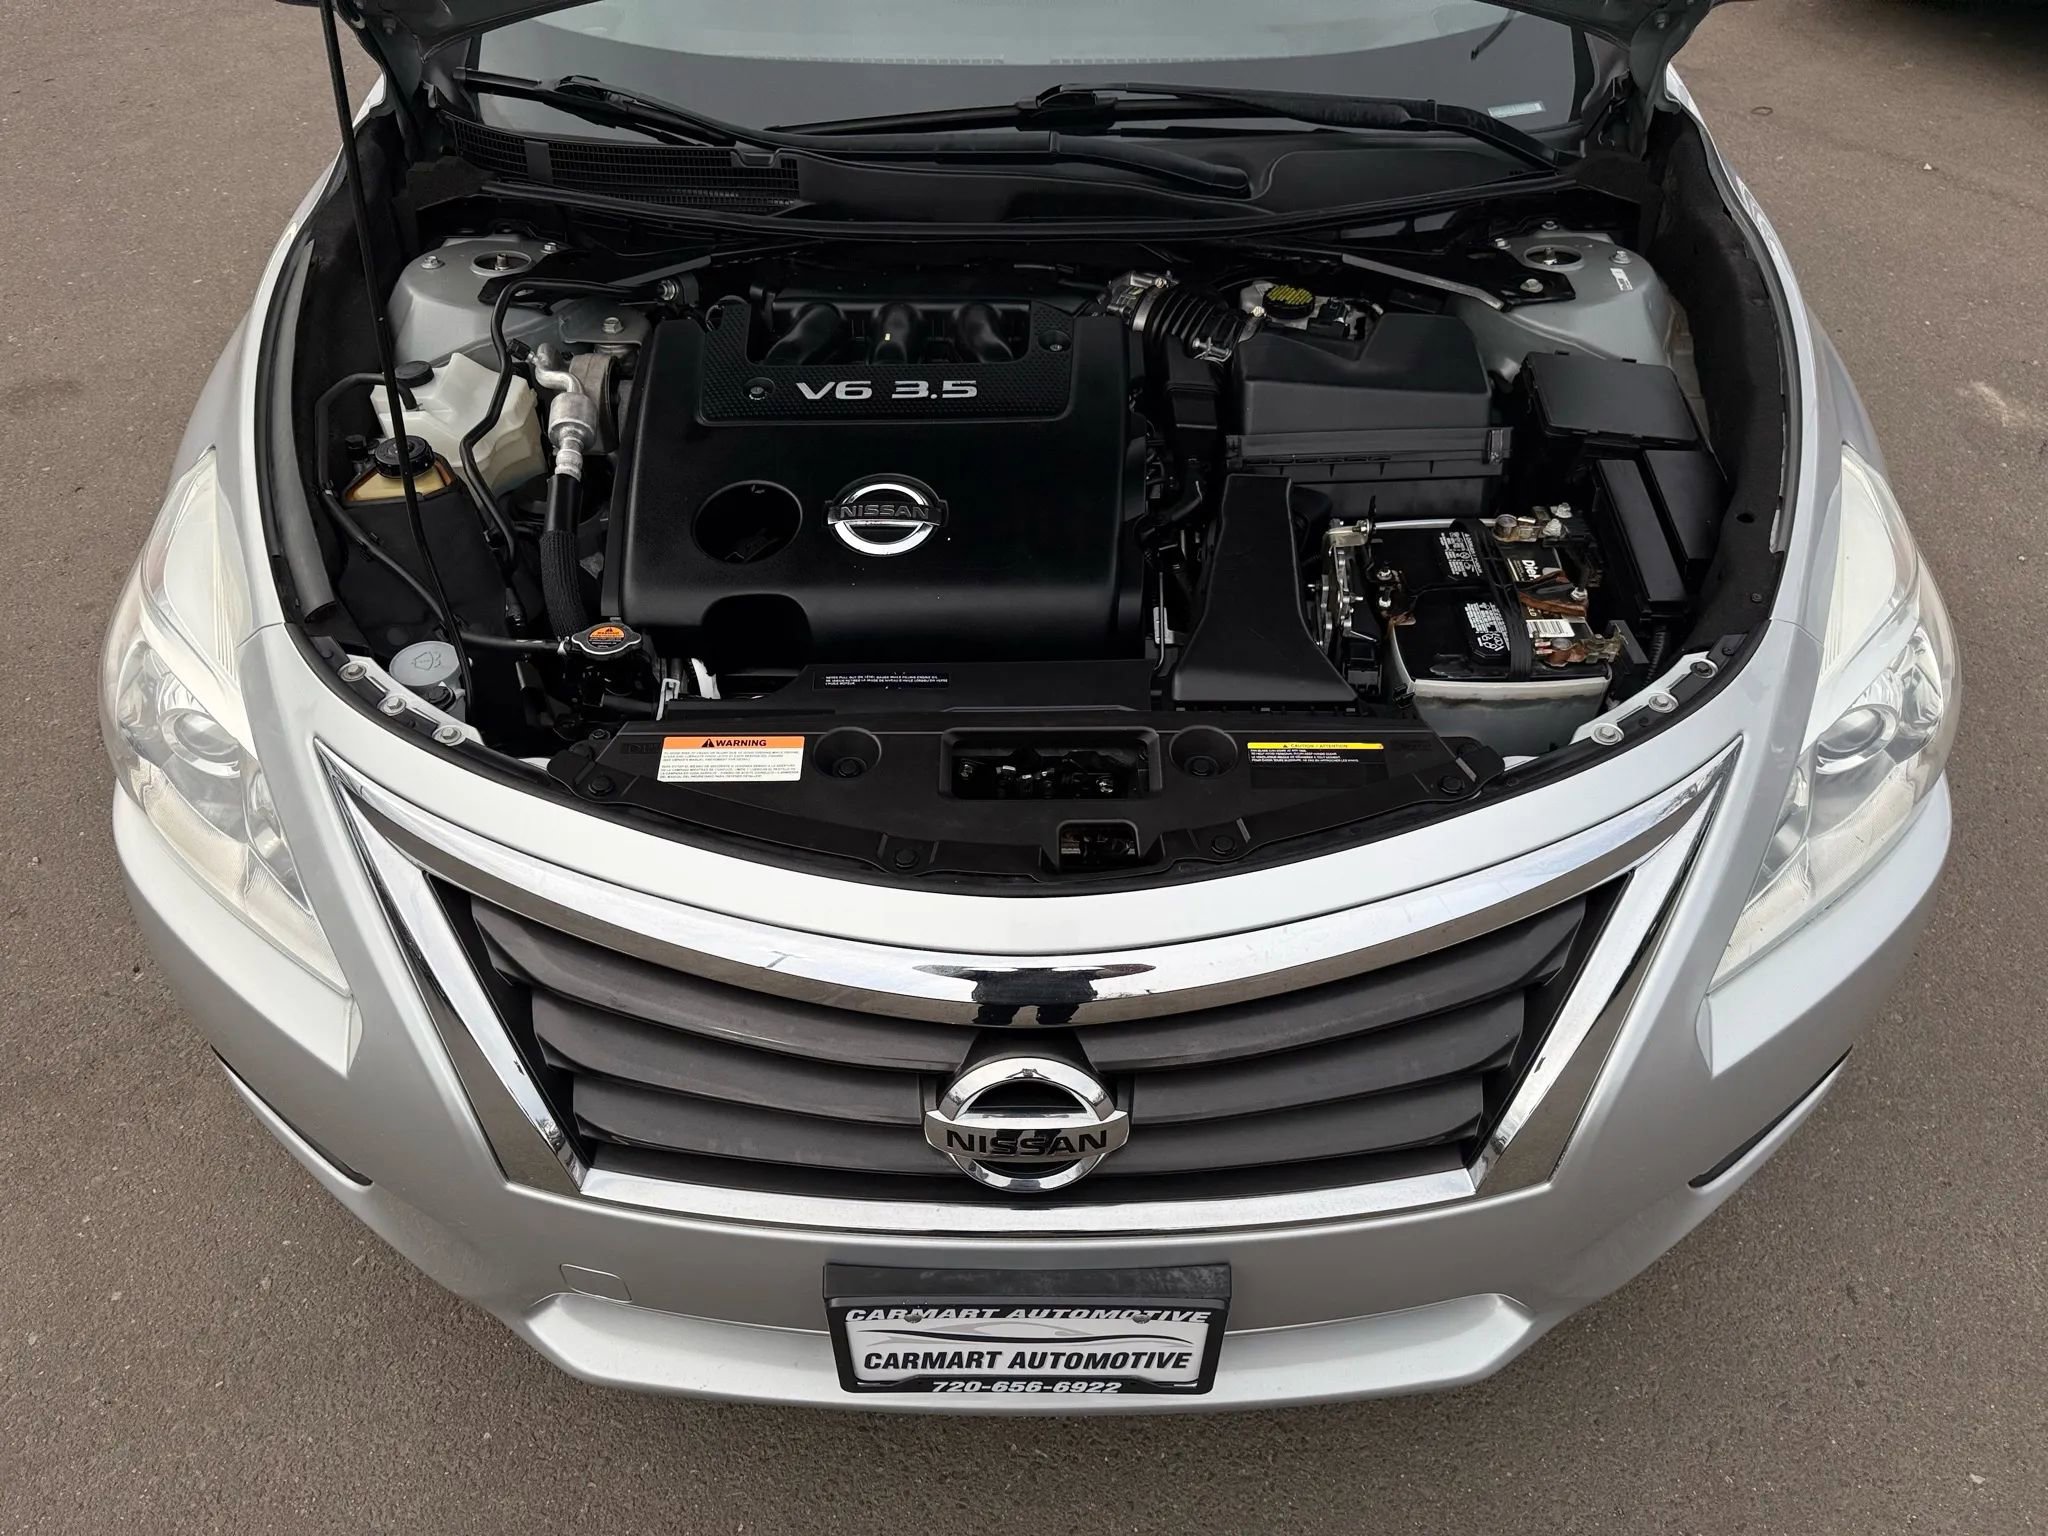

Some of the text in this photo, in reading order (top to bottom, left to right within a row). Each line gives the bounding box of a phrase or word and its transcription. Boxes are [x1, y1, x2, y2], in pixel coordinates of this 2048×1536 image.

[795, 380, 978, 400] V6 3.5
[840, 504, 929, 519] NISSAN
[716, 739, 767, 747] WARNING
[946, 1129, 1107, 1155] NISSAN
[845, 1308, 1212, 1323] CARMART AUTOMOTIVE
[864, 1350, 1193, 1370] CARMART AUTOMOTIVE
[932, 1380, 1122, 1393] 720-656-6922
